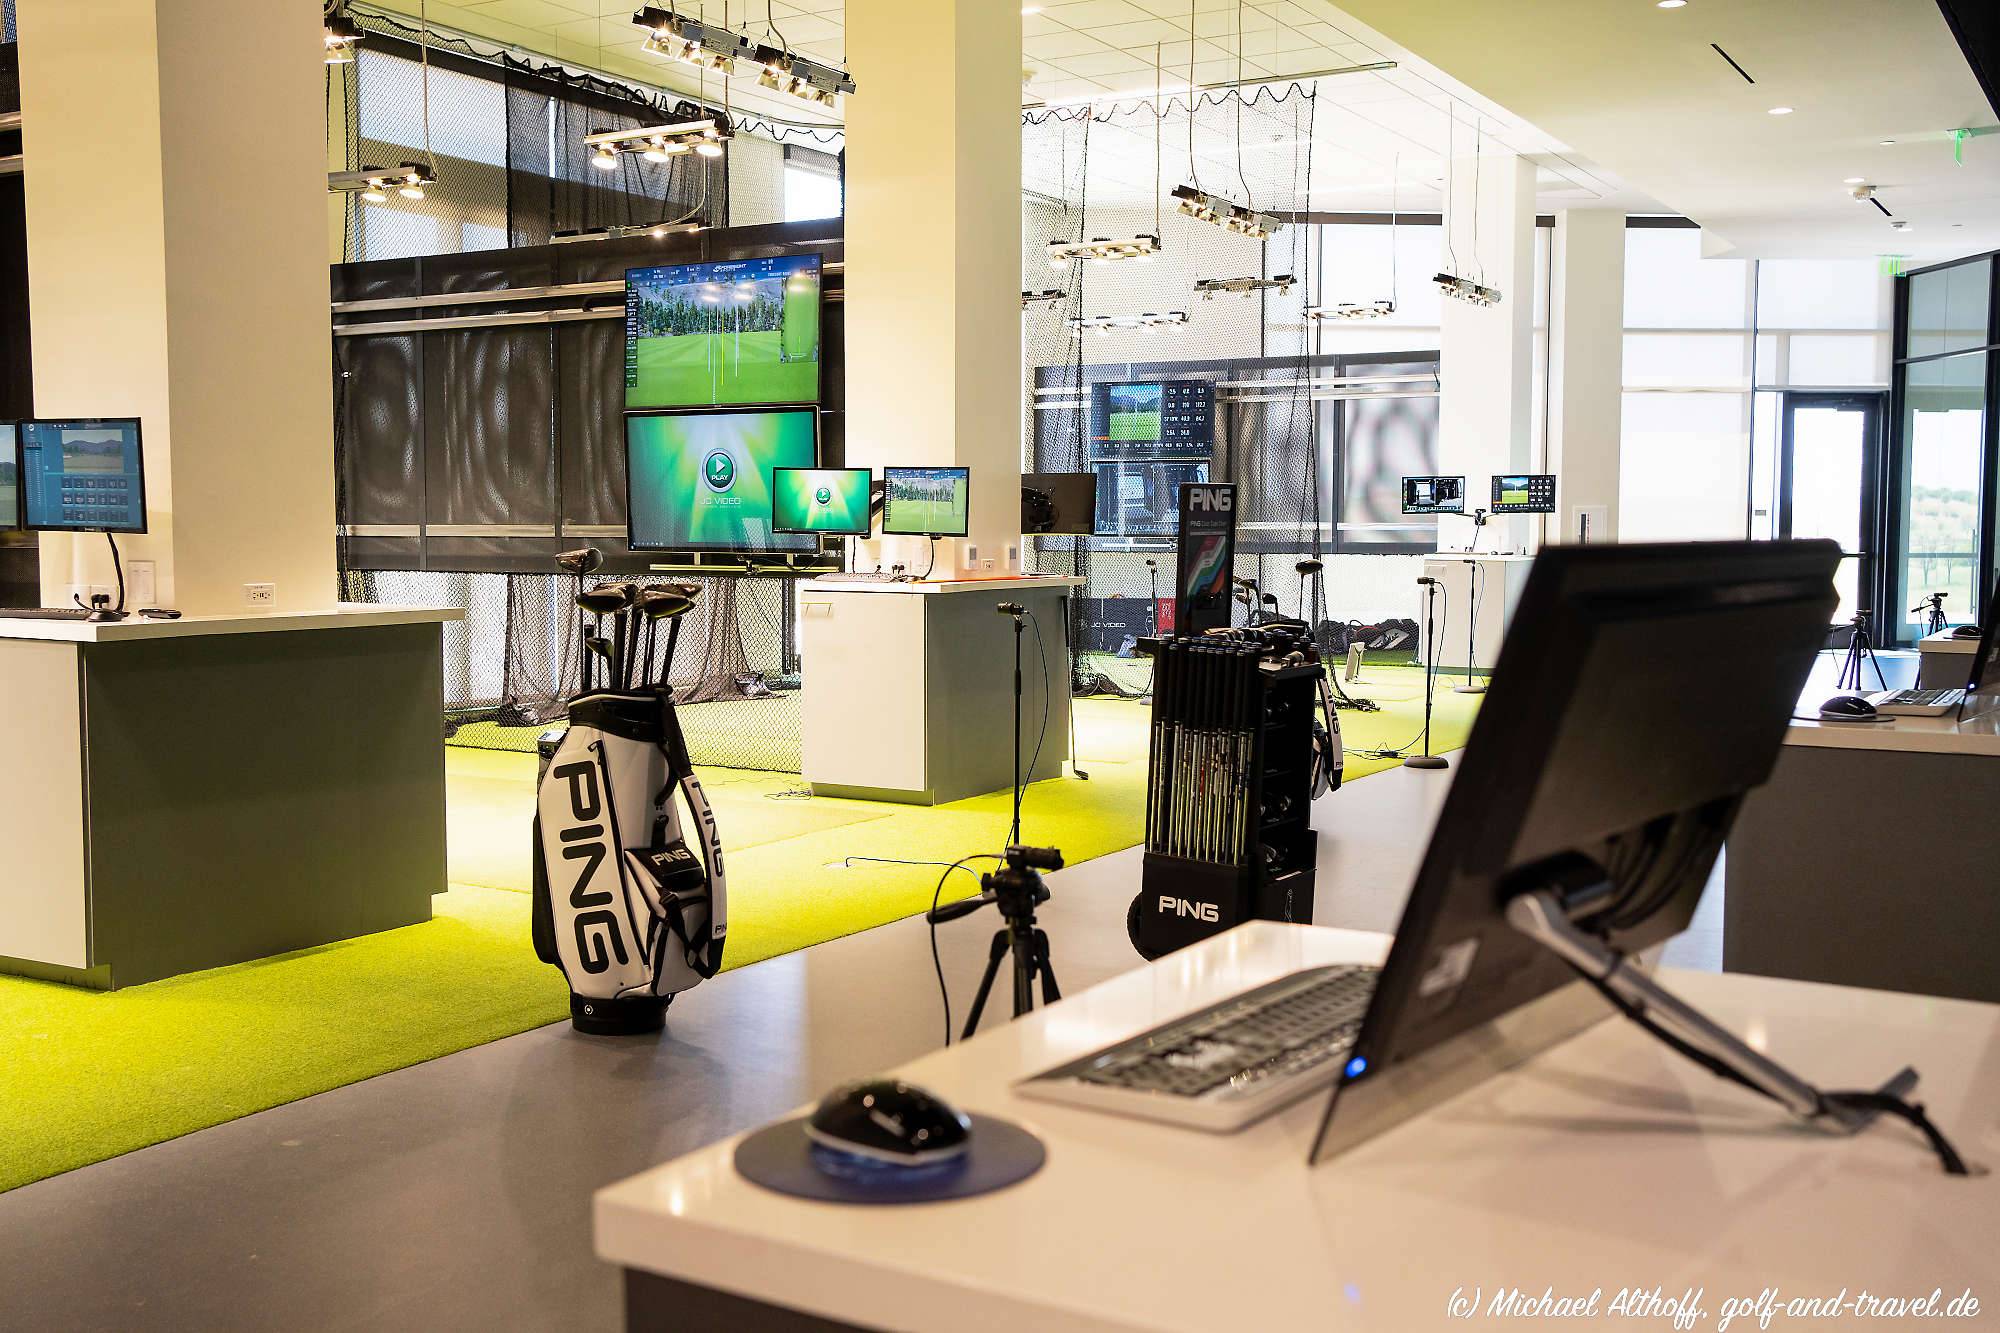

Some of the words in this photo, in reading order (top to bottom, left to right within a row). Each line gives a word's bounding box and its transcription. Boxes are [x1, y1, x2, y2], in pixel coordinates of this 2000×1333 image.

[714, 497, 741, 505] VIDEO
[1189, 488, 1232, 512] PING
[553, 760, 629, 975] PING
[650, 849, 691, 866] PING
[1158, 895, 1219, 923] PING
